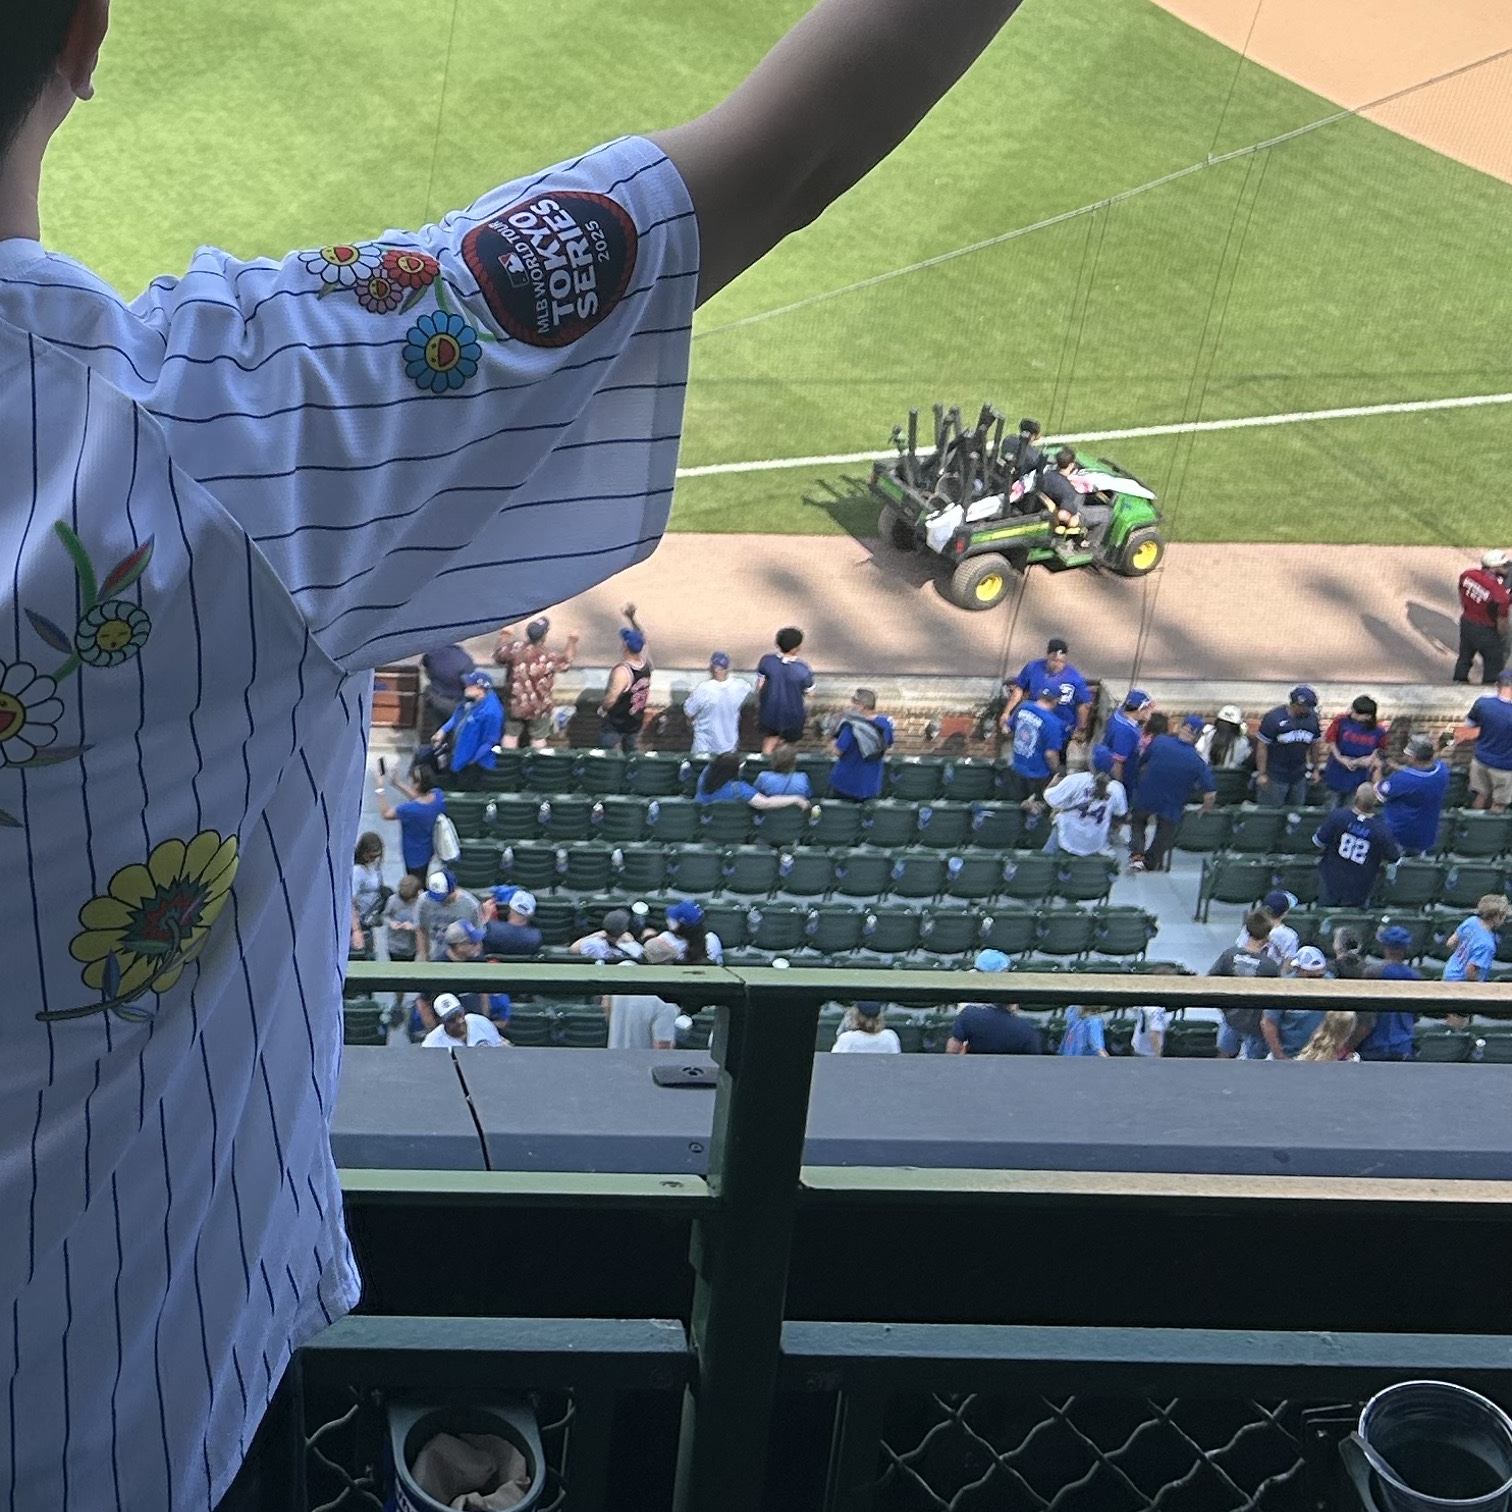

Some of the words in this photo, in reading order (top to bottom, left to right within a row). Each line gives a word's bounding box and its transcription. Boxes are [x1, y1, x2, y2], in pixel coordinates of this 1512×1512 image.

[489, 220, 521, 245] TOUR
[585, 220, 610, 263] 2025
[508, 212, 574, 326] TOKYO
[514, 241, 546, 298] WORLD
[530, 199, 599, 319] SERIES
[536, 299, 550, 333] MLB
